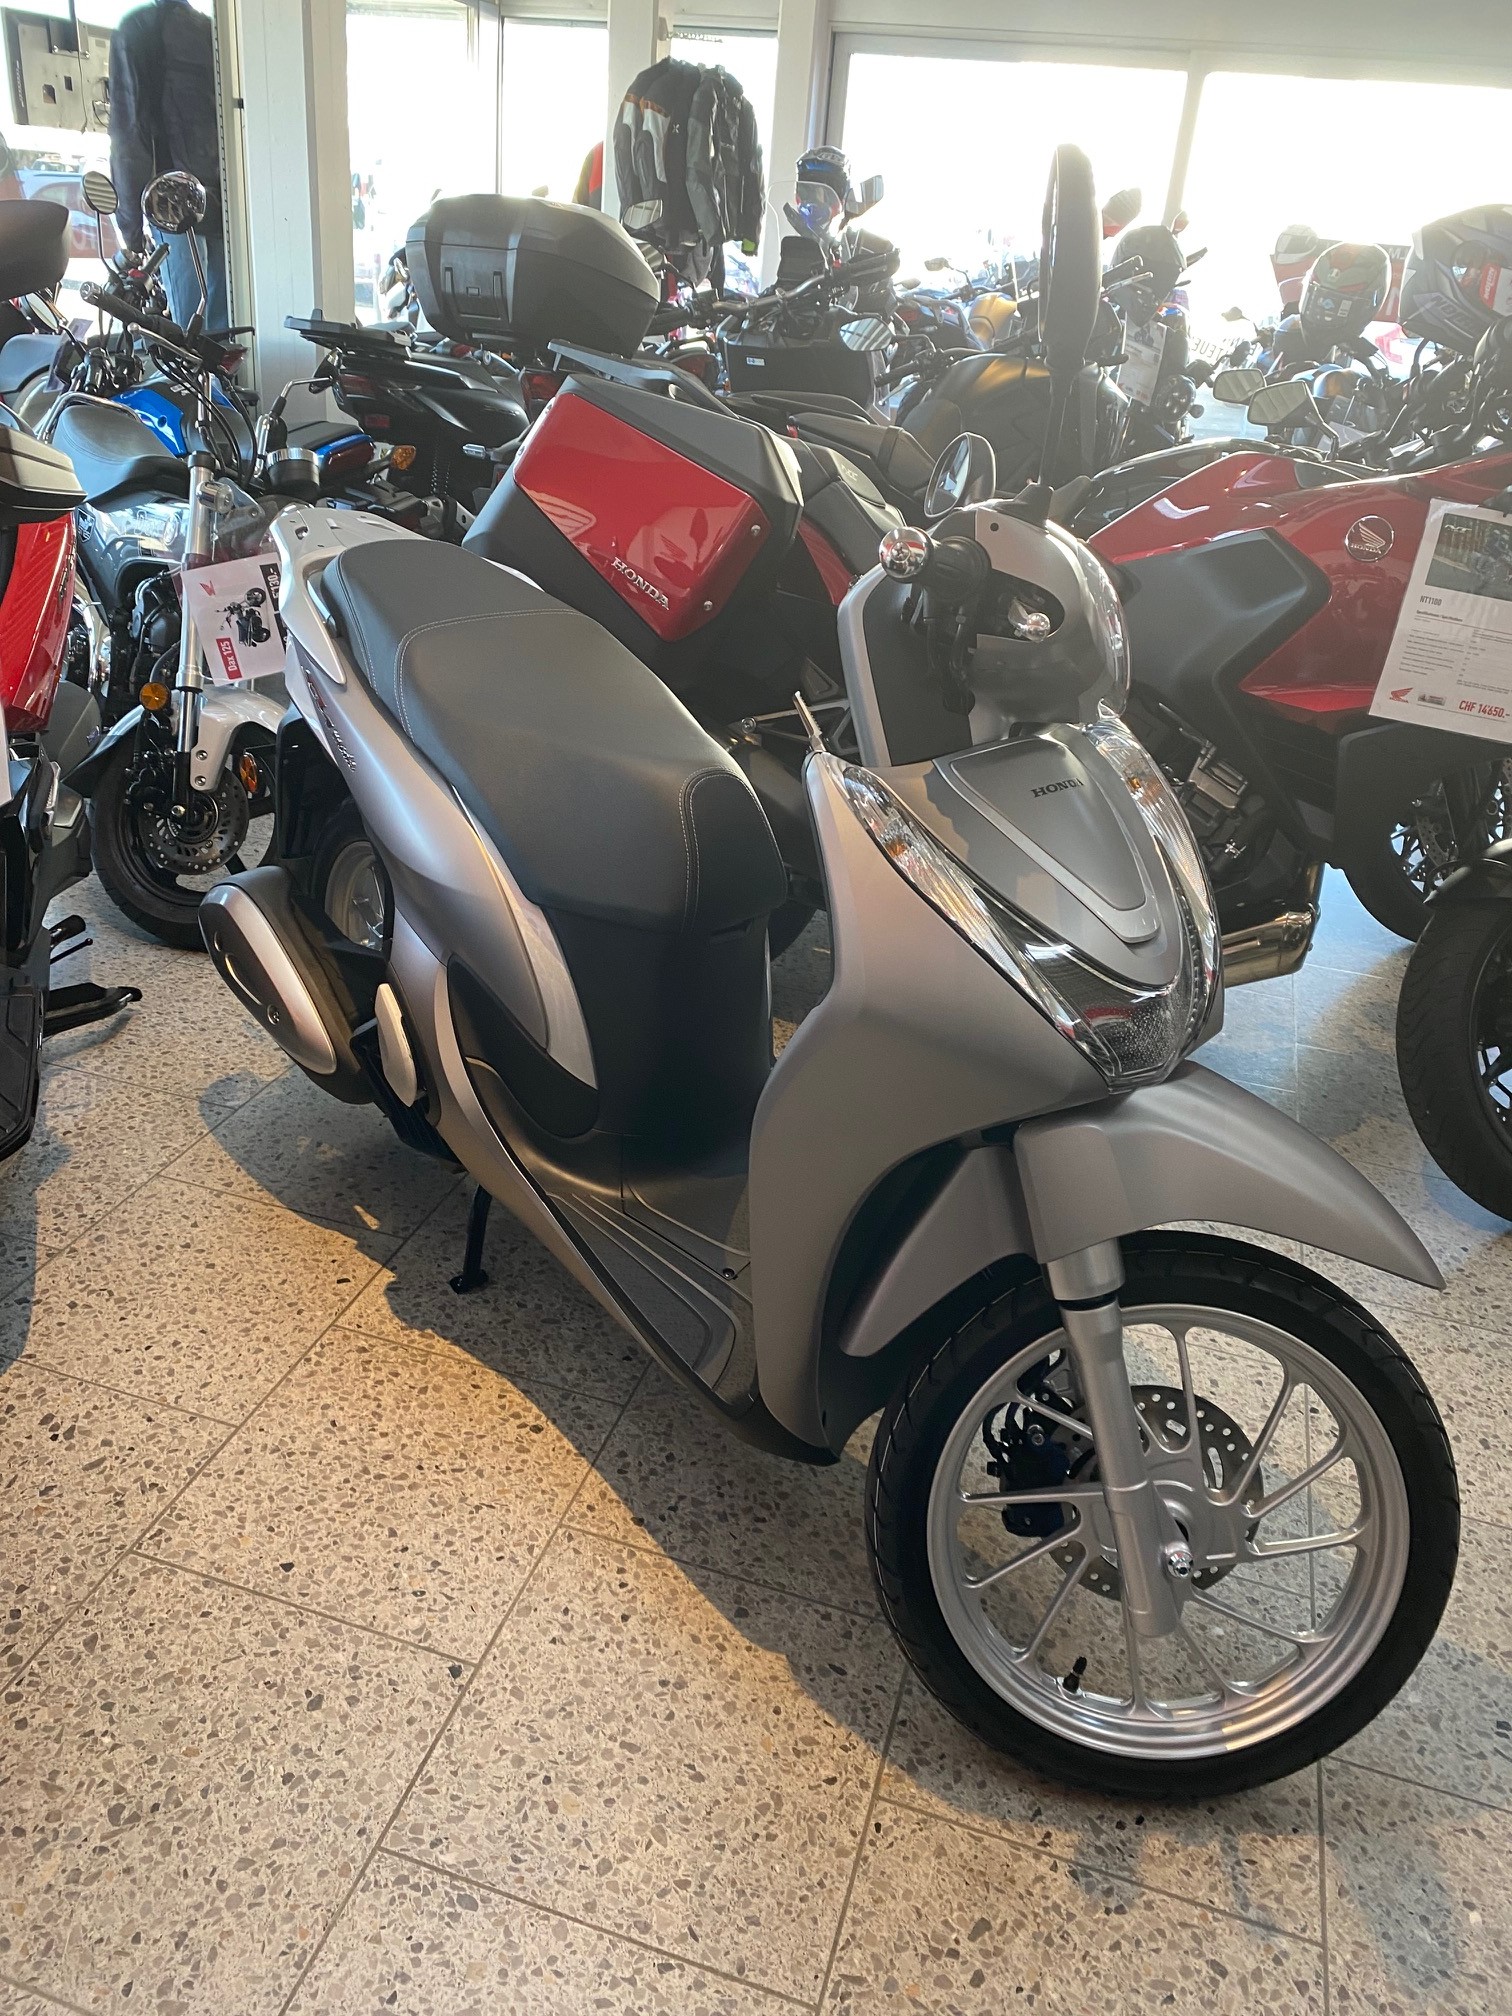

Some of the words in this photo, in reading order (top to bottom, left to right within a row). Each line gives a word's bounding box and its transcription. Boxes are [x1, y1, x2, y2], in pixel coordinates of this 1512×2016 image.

[611, 556, 670, 611] HONDA
[1419, 595, 1442, 607] NT1100
[221, 641, 231, 656] 125
[226, 654, 238, 671] Dax
[1459, 700, 1477, 711] CHF
[1030, 777, 1084, 798] HONDA
